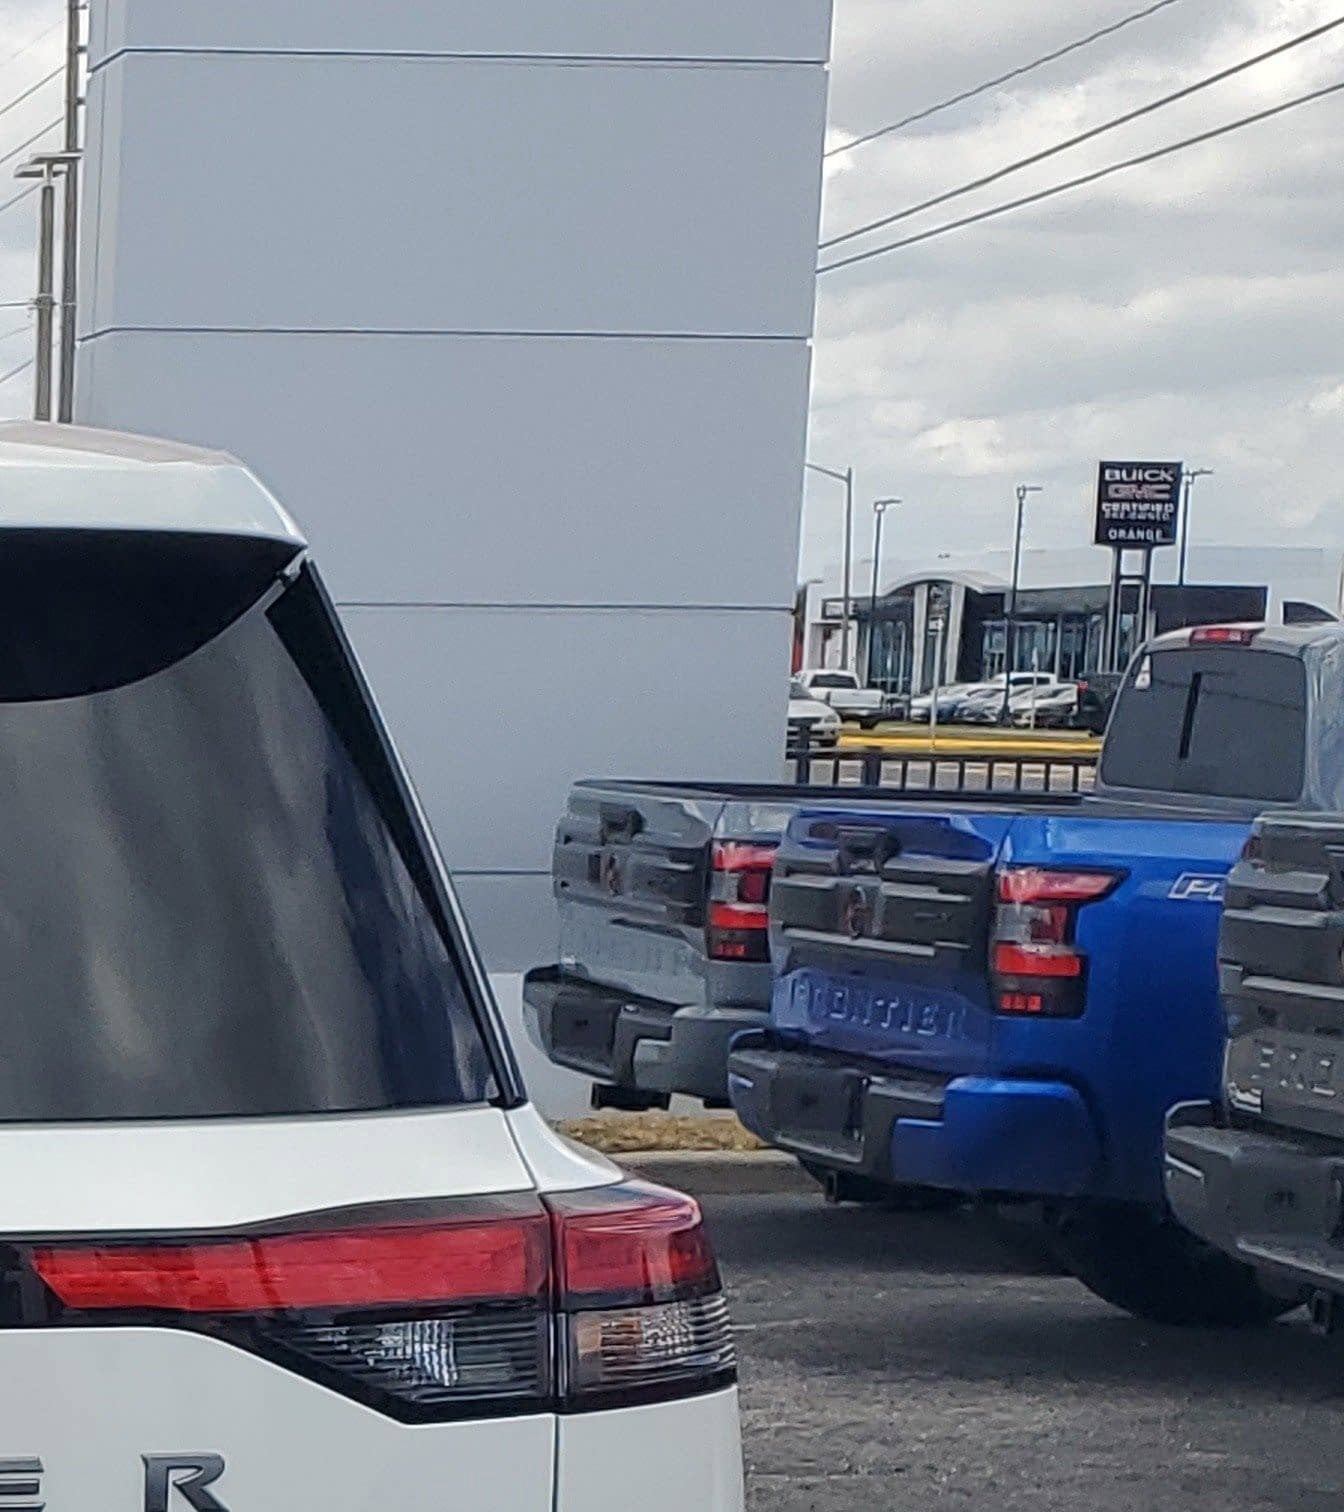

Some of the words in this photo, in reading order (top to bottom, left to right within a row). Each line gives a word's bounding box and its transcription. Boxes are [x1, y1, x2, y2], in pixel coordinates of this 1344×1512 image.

[1104, 468, 1174, 482] BUICK
[1102, 502, 1174, 513] CERTIFIED
[1108, 528, 1163, 542] ORANGE
